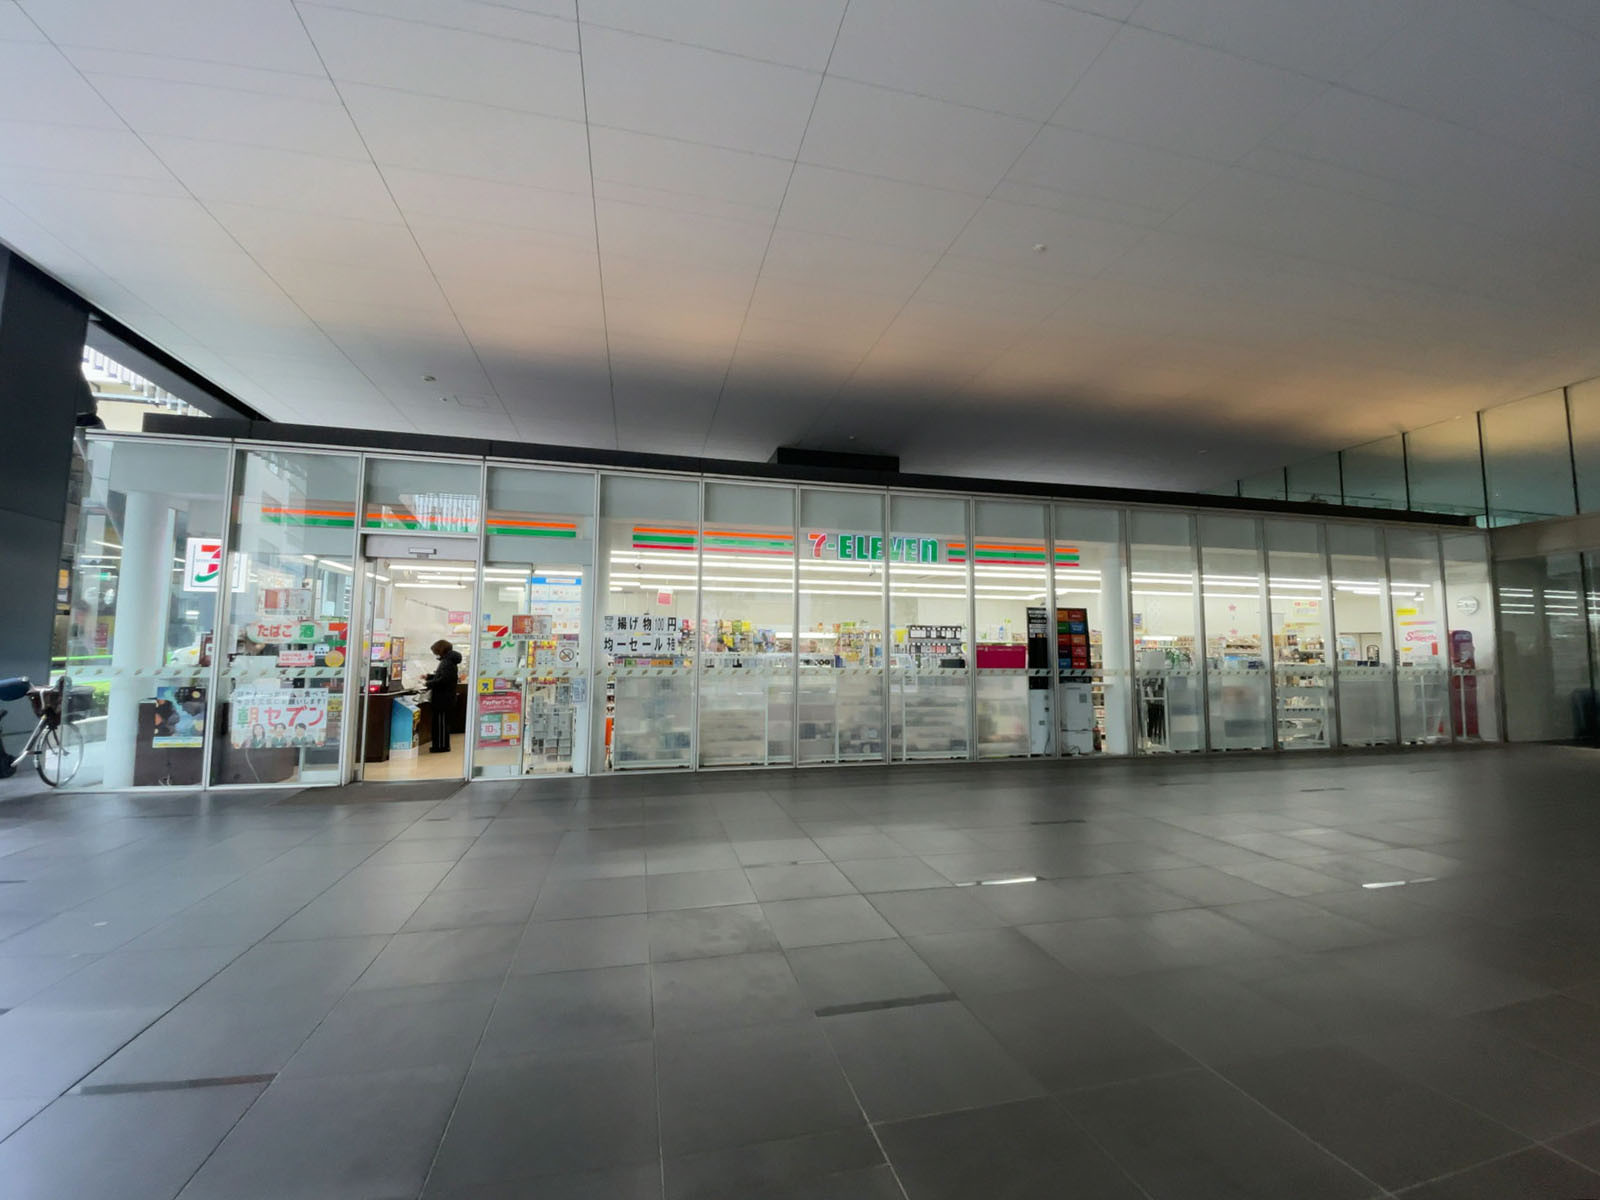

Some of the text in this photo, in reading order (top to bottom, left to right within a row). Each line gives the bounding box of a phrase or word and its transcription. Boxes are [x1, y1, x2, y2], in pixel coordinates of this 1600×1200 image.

[257, 624, 315, 638] たばこ 酒
[237, 704, 325, 728] 朝セブン
